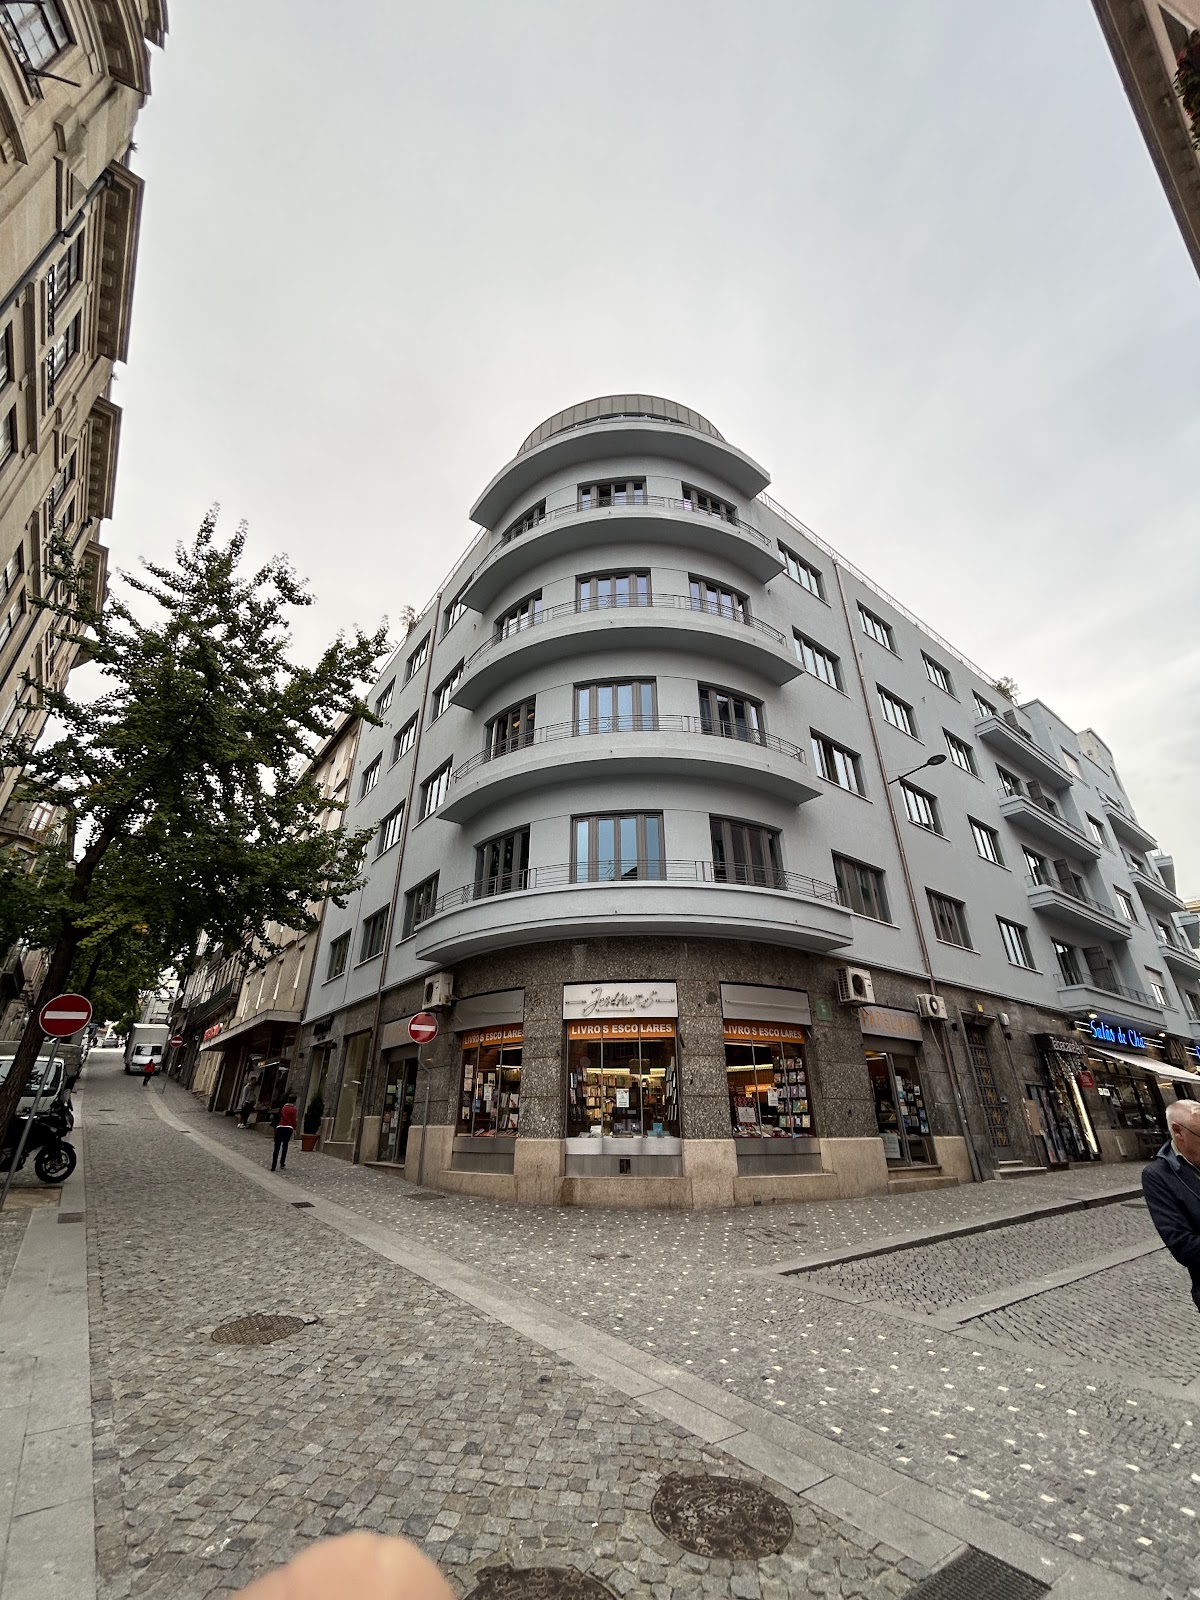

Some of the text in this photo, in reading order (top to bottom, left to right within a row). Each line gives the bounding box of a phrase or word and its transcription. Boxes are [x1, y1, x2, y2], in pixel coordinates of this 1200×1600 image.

[571, 1023, 673, 1035] LIVROS ESCOLARES
[723, 1025, 802, 1040] LIVROS ESCOLARES
[464, 1033, 485, 1045] LIVROS
[1117, 1026, 1128, 1045] de
[1128, 1029, 1147, 1049] Chá
